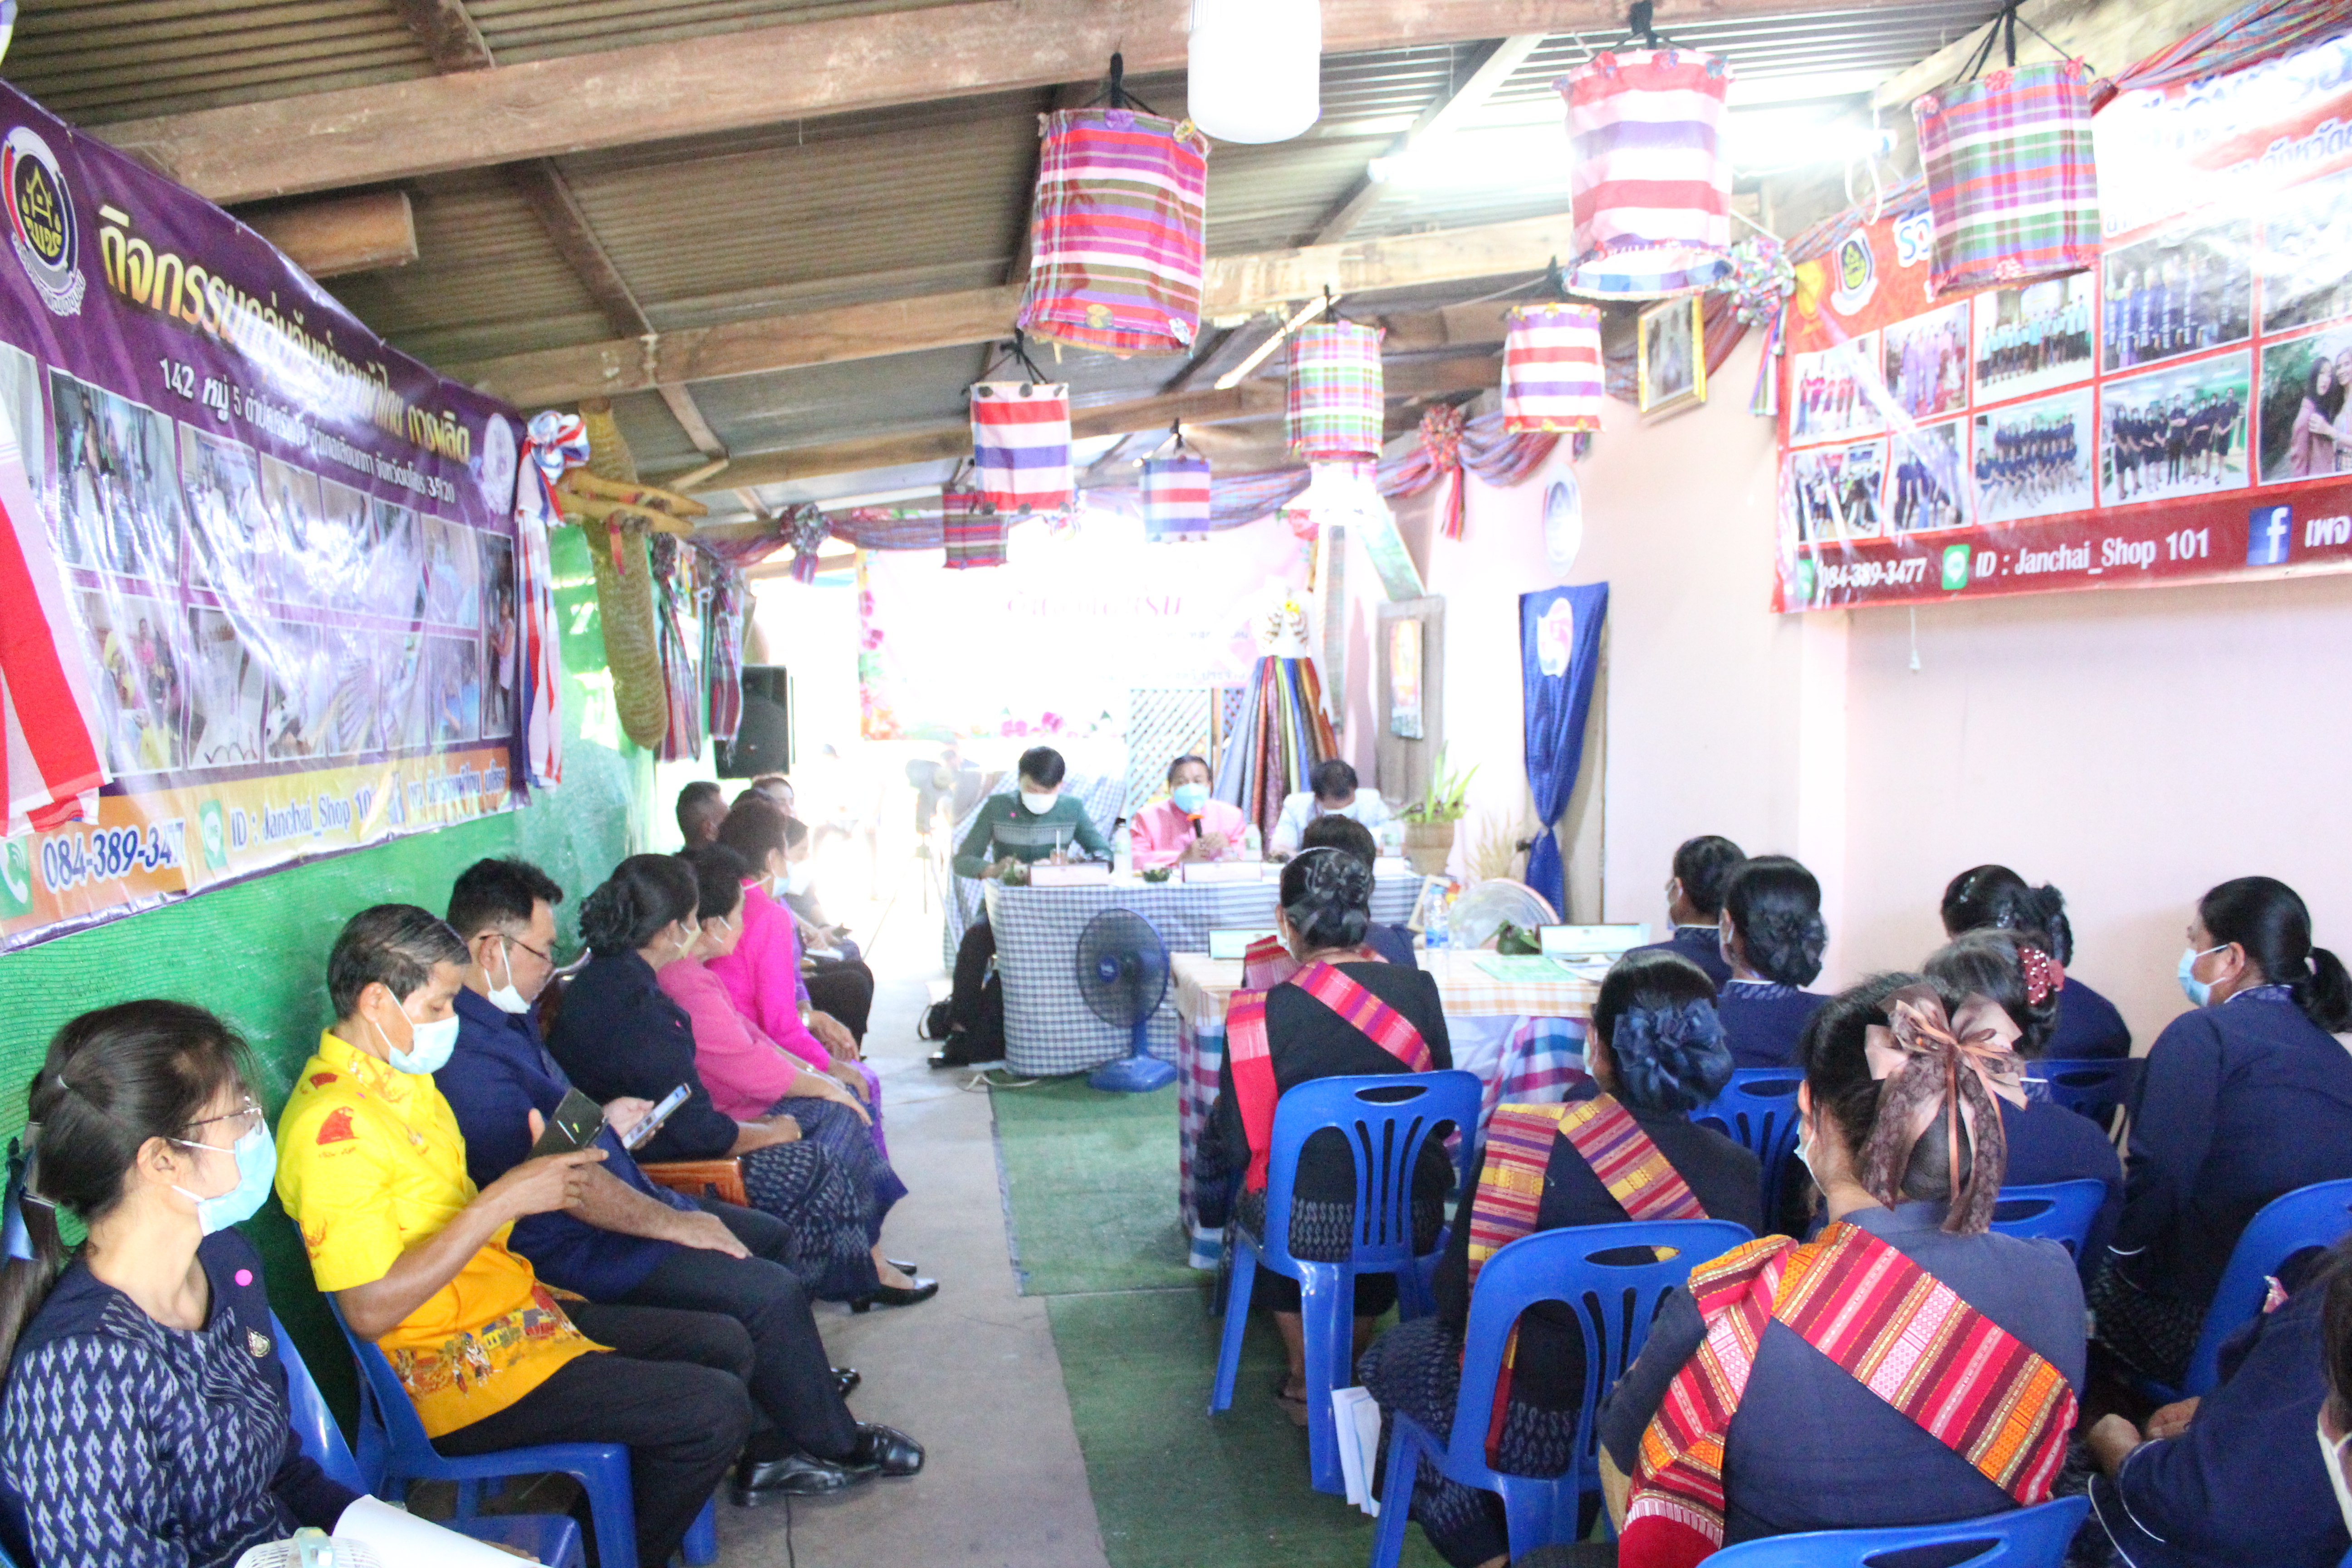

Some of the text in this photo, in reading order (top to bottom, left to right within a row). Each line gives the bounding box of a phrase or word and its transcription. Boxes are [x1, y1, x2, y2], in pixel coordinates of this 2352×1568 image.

[160, 358, 194, 399] 142
[203, 375, 229, 422] หมู่
[234, 386, 242, 416] 5
[1818, 528, 2209, 589] 084-389-3477 ID : Janchai_Shop 101
[44, 822, 184, 888] 084-389-3477
[231, 811, 247, 847] ID
[263, 798, 350, 837] Janchai_Shop
